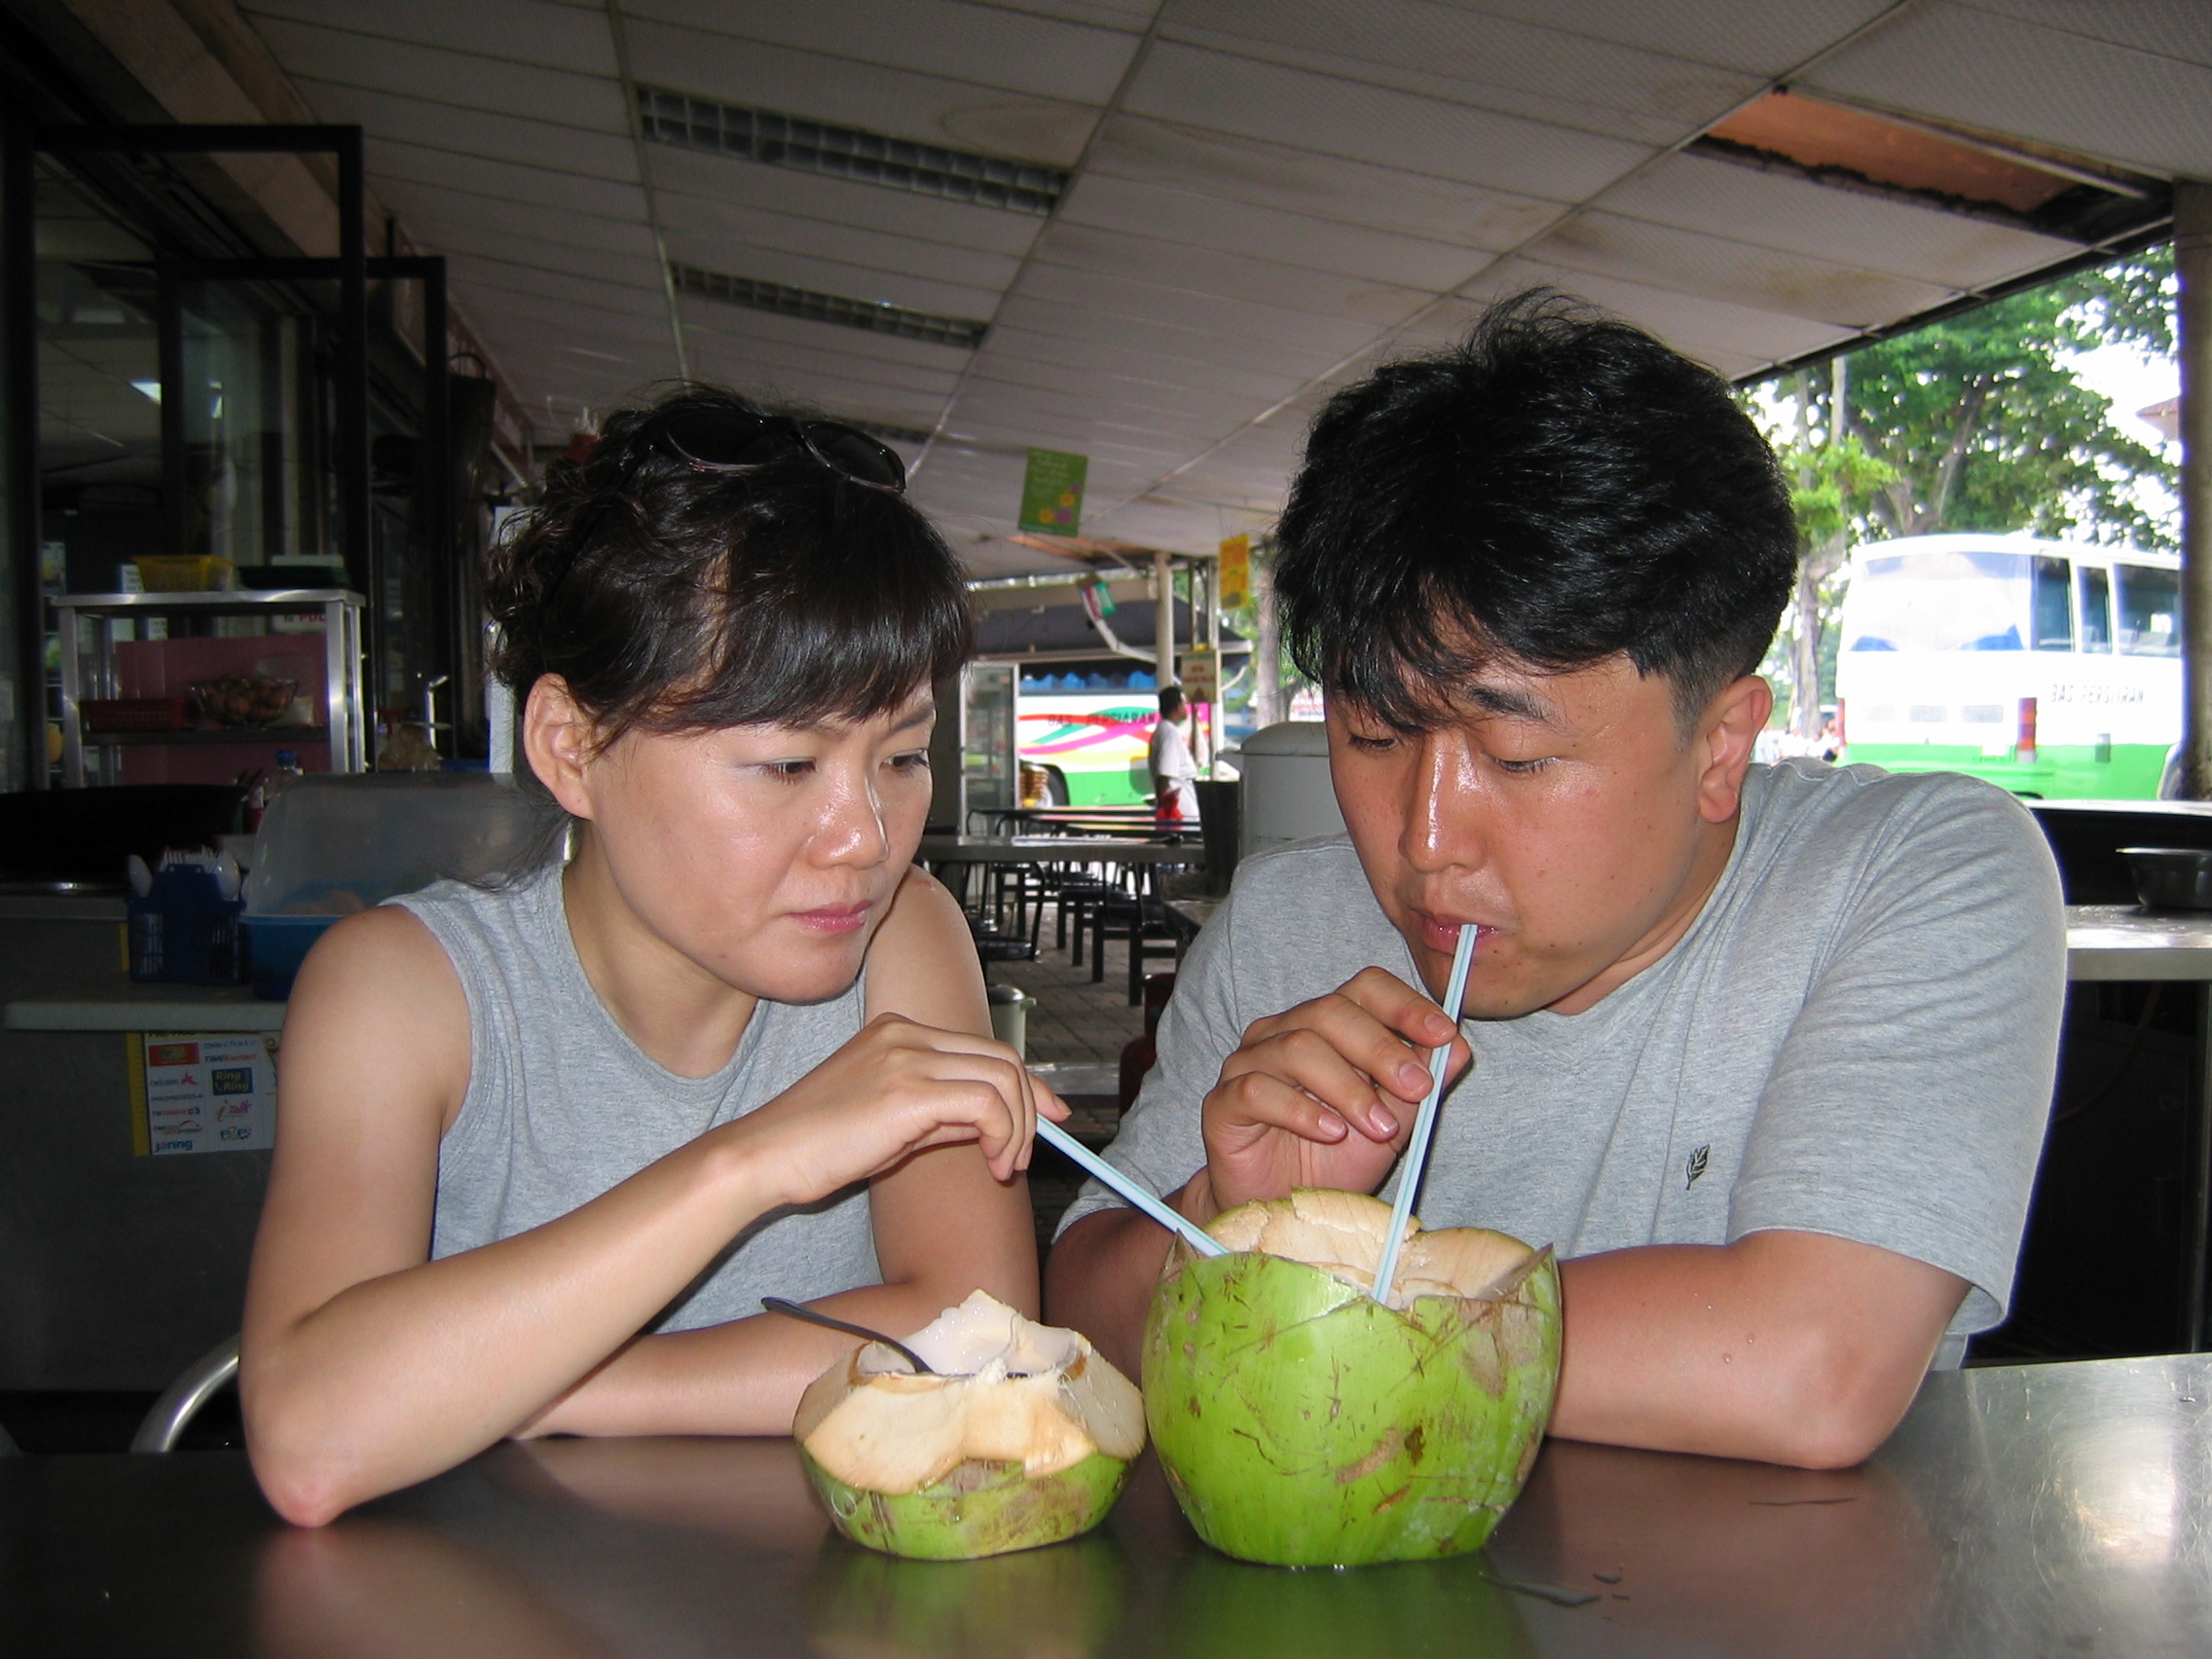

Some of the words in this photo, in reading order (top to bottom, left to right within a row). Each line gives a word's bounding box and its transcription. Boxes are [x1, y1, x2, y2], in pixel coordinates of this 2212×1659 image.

[2049, 683, 2074, 702] BAS
[216, 1071, 241, 1082] Ring
[224, 1082, 249, 1092] Ring
[156, 1139, 193, 1152] jaring
